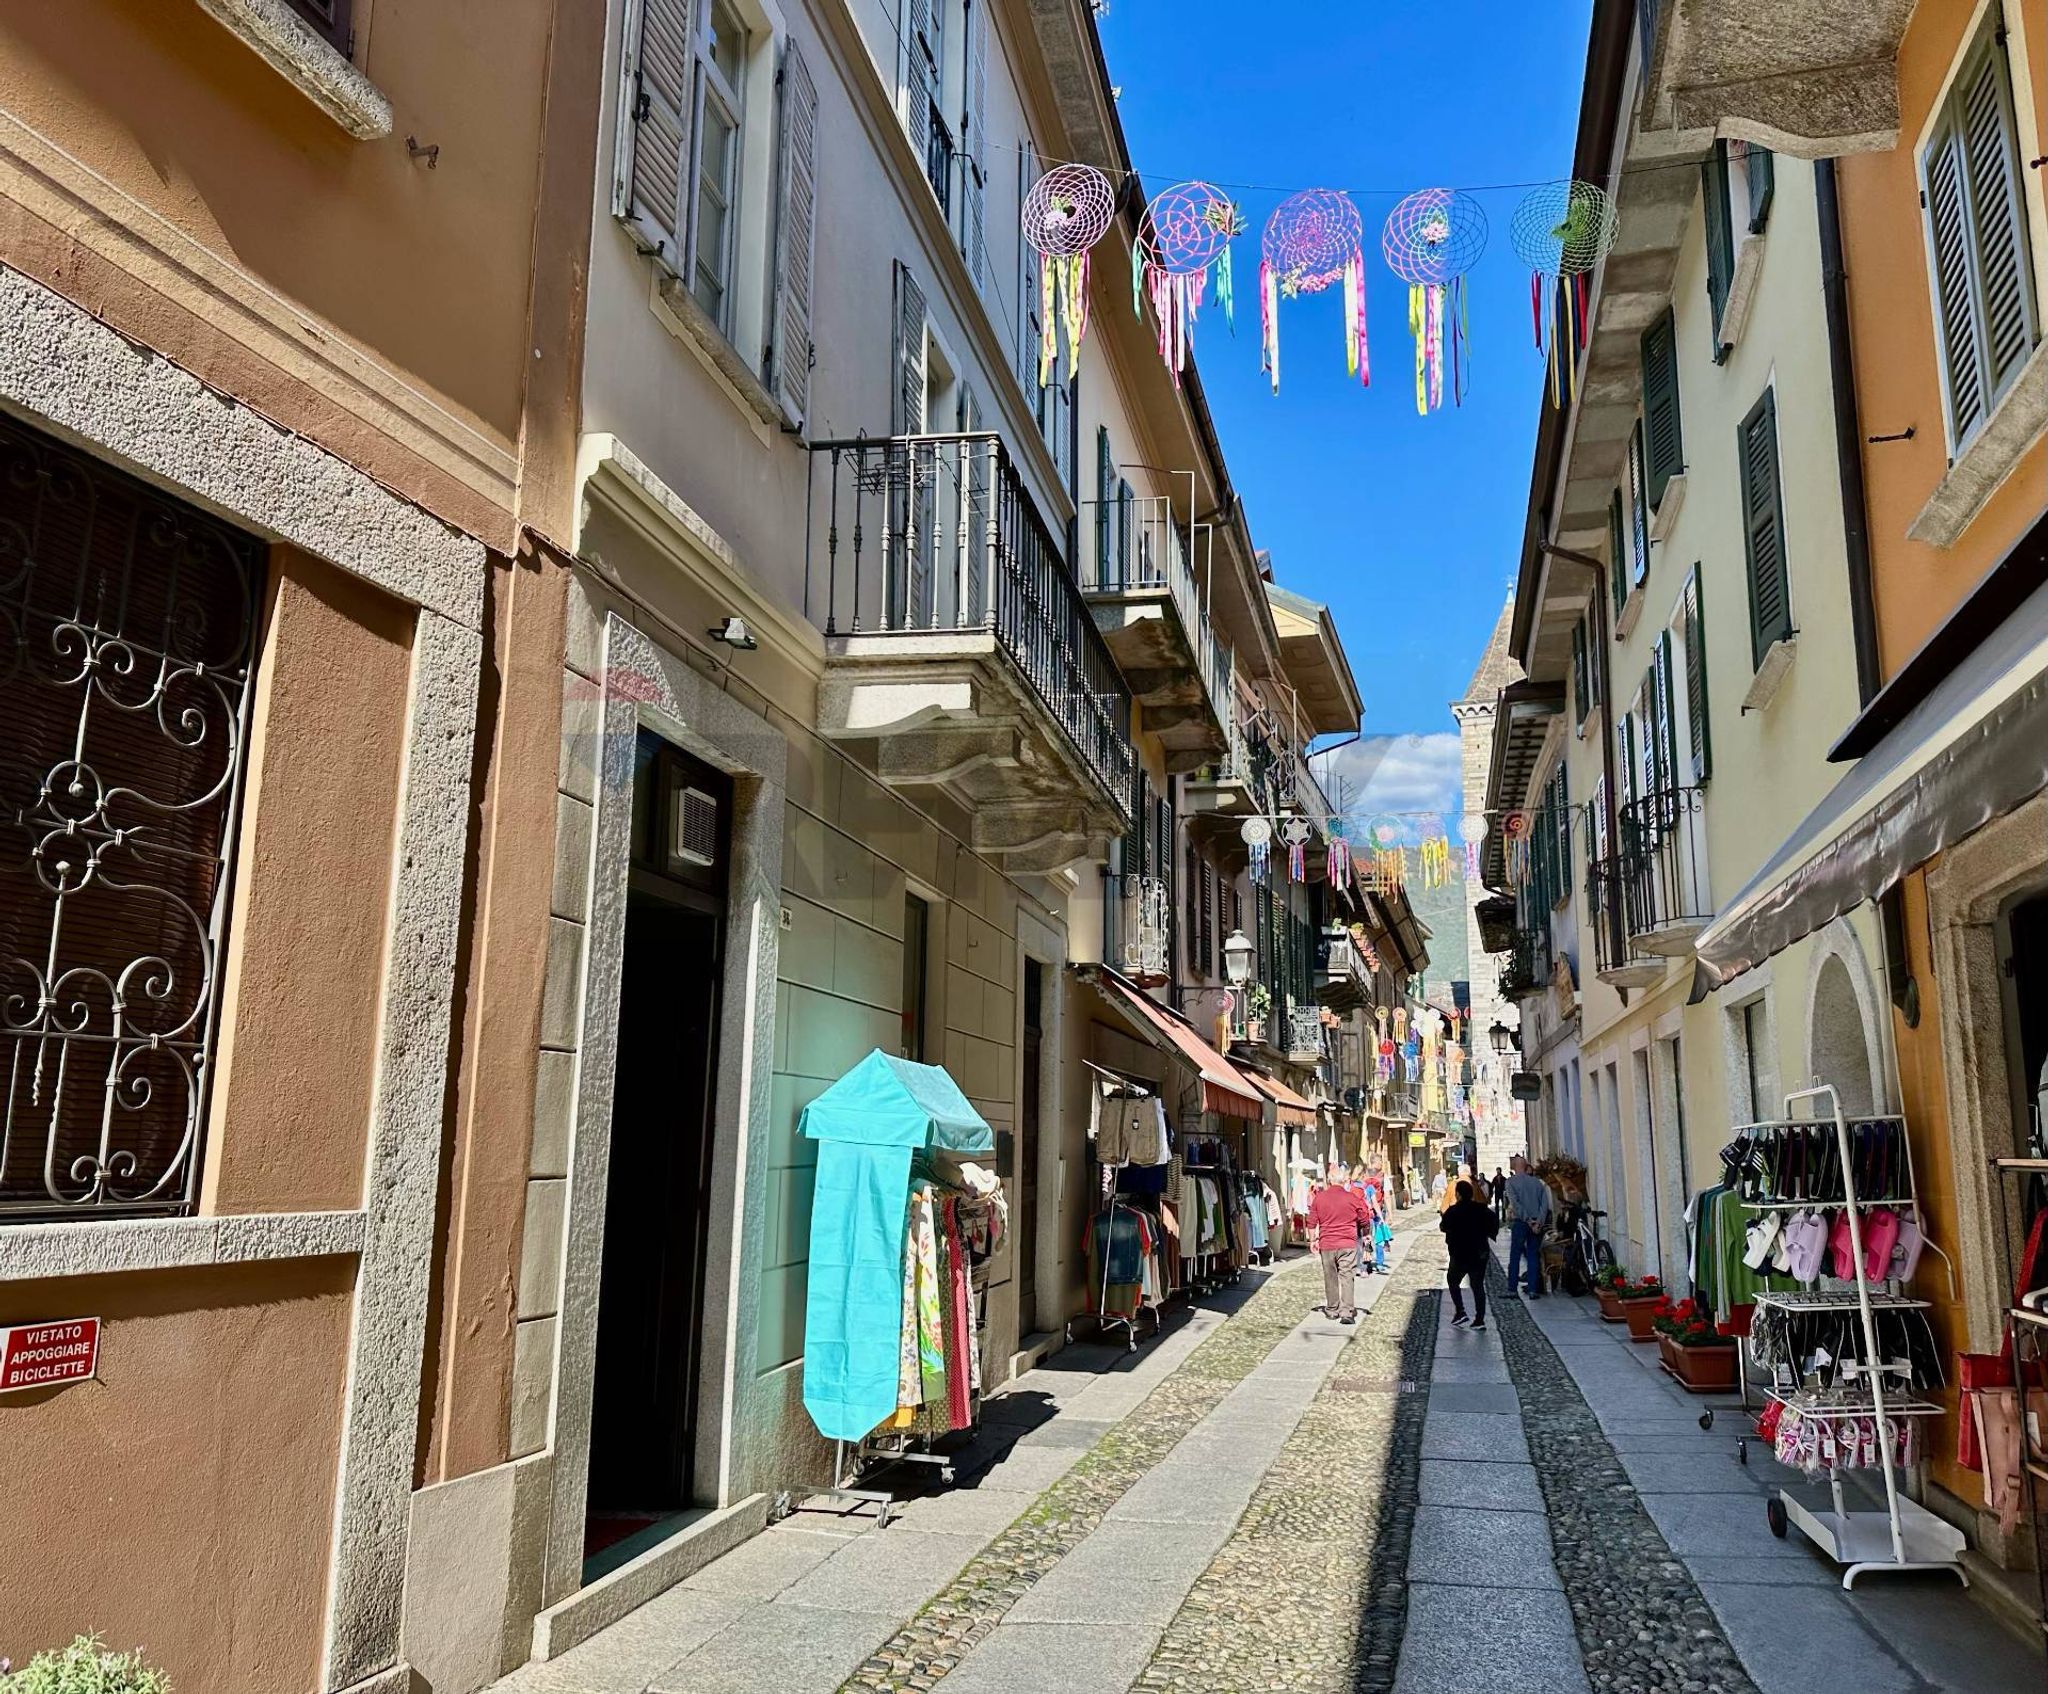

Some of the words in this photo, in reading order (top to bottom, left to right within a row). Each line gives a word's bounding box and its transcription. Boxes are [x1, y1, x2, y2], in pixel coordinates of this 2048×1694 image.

[27, 1325, 82, 1345] VIETATO
[10, 1342, 91, 1365] APPOGGIARE
[9, 1360, 86, 1384] BICICLETTE
